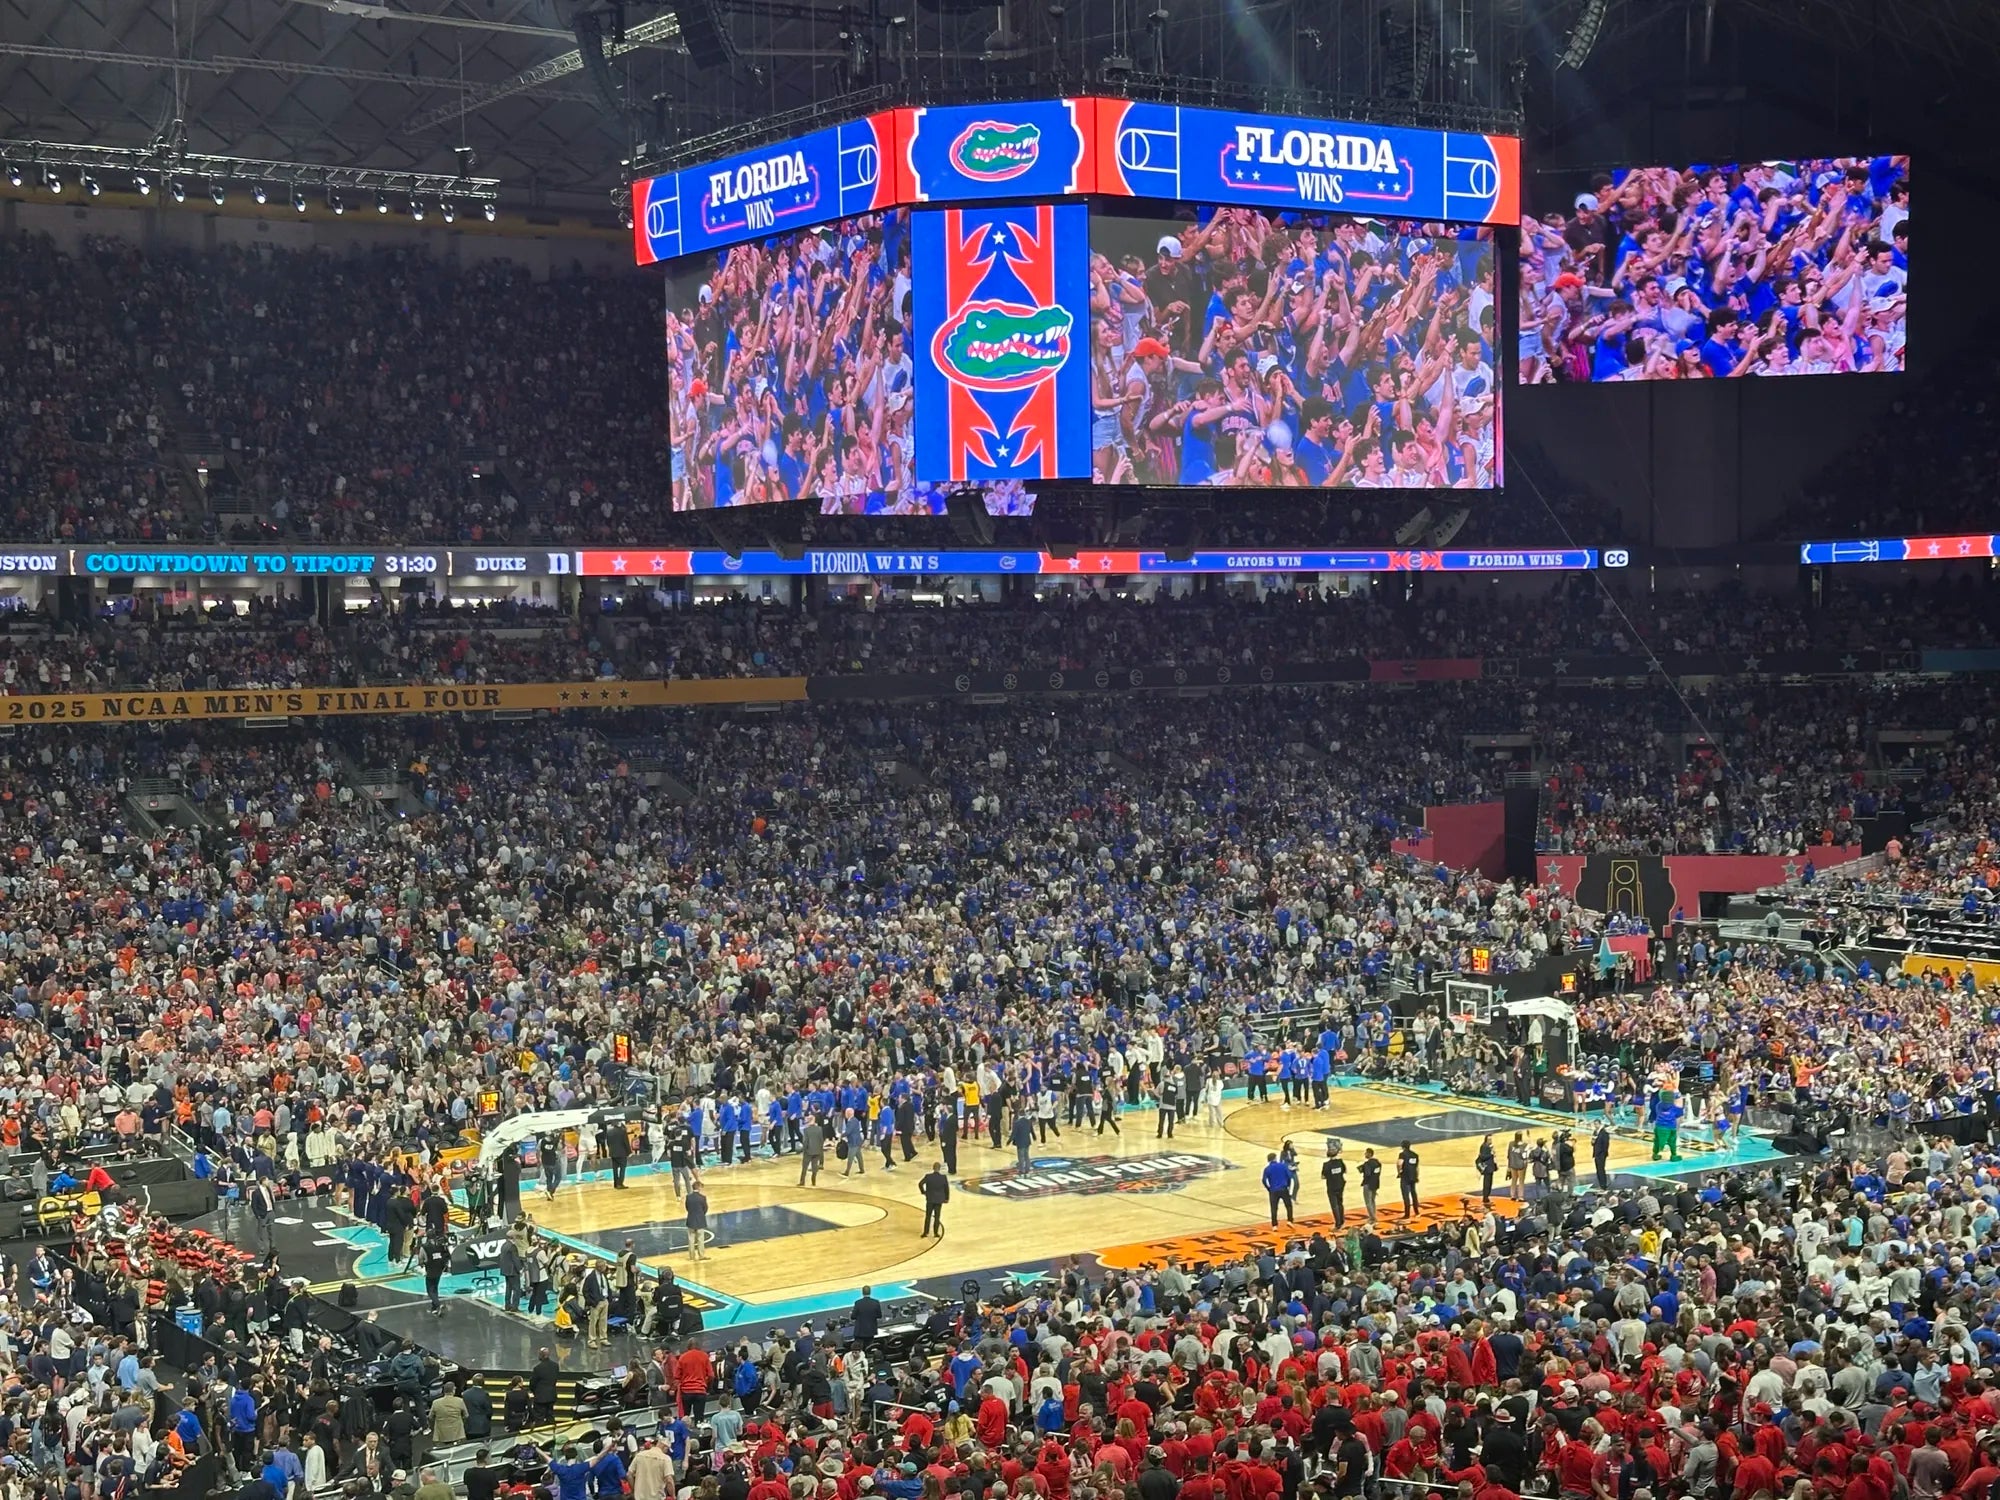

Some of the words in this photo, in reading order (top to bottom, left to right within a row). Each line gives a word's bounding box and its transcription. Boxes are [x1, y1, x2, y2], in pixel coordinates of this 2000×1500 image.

[1235, 126, 1399, 174] FLORIDA
[709, 150, 809, 208] FLORIDA
[1296, 171, 1343, 203] WINS
[744, 198, 775, 230] WINS
[86, 554, 248, 573] COUNTDOWN
[253, 555, 286, 573] TO
[291, 555, 375, 573] TIPOFF
[385, 556, 437, 573] 31:30
[475, 557, 526, 571] DUKE
[811, 552, 870, 573] FLORIDA
[875, 555, 939, 570] WINS
[1227, 556, 1274, 567] GATORS
[1469, 554, 1525, 566] FLORIDA
[1529, 554, 1563, 565] WINS
[1607, 553, 1626, 564] CC
[9, 701, 86, 719] 2025
[102, 697, 190, 716] NCAA
[204, 694, 303, 714] MEN'S
[317, 691, 410, 711] FINAL
[424, 689, 502, 708] FOUR
[979, 1167, 1106, 1195] FINAL
[1094, 1155, 1211, 1177] FOUR
[1147, 1229, 1272, 1250] THE
[1299, 1201, 1446, 1229] ROAD
[1807, 1231, 1815, 1241] 2
